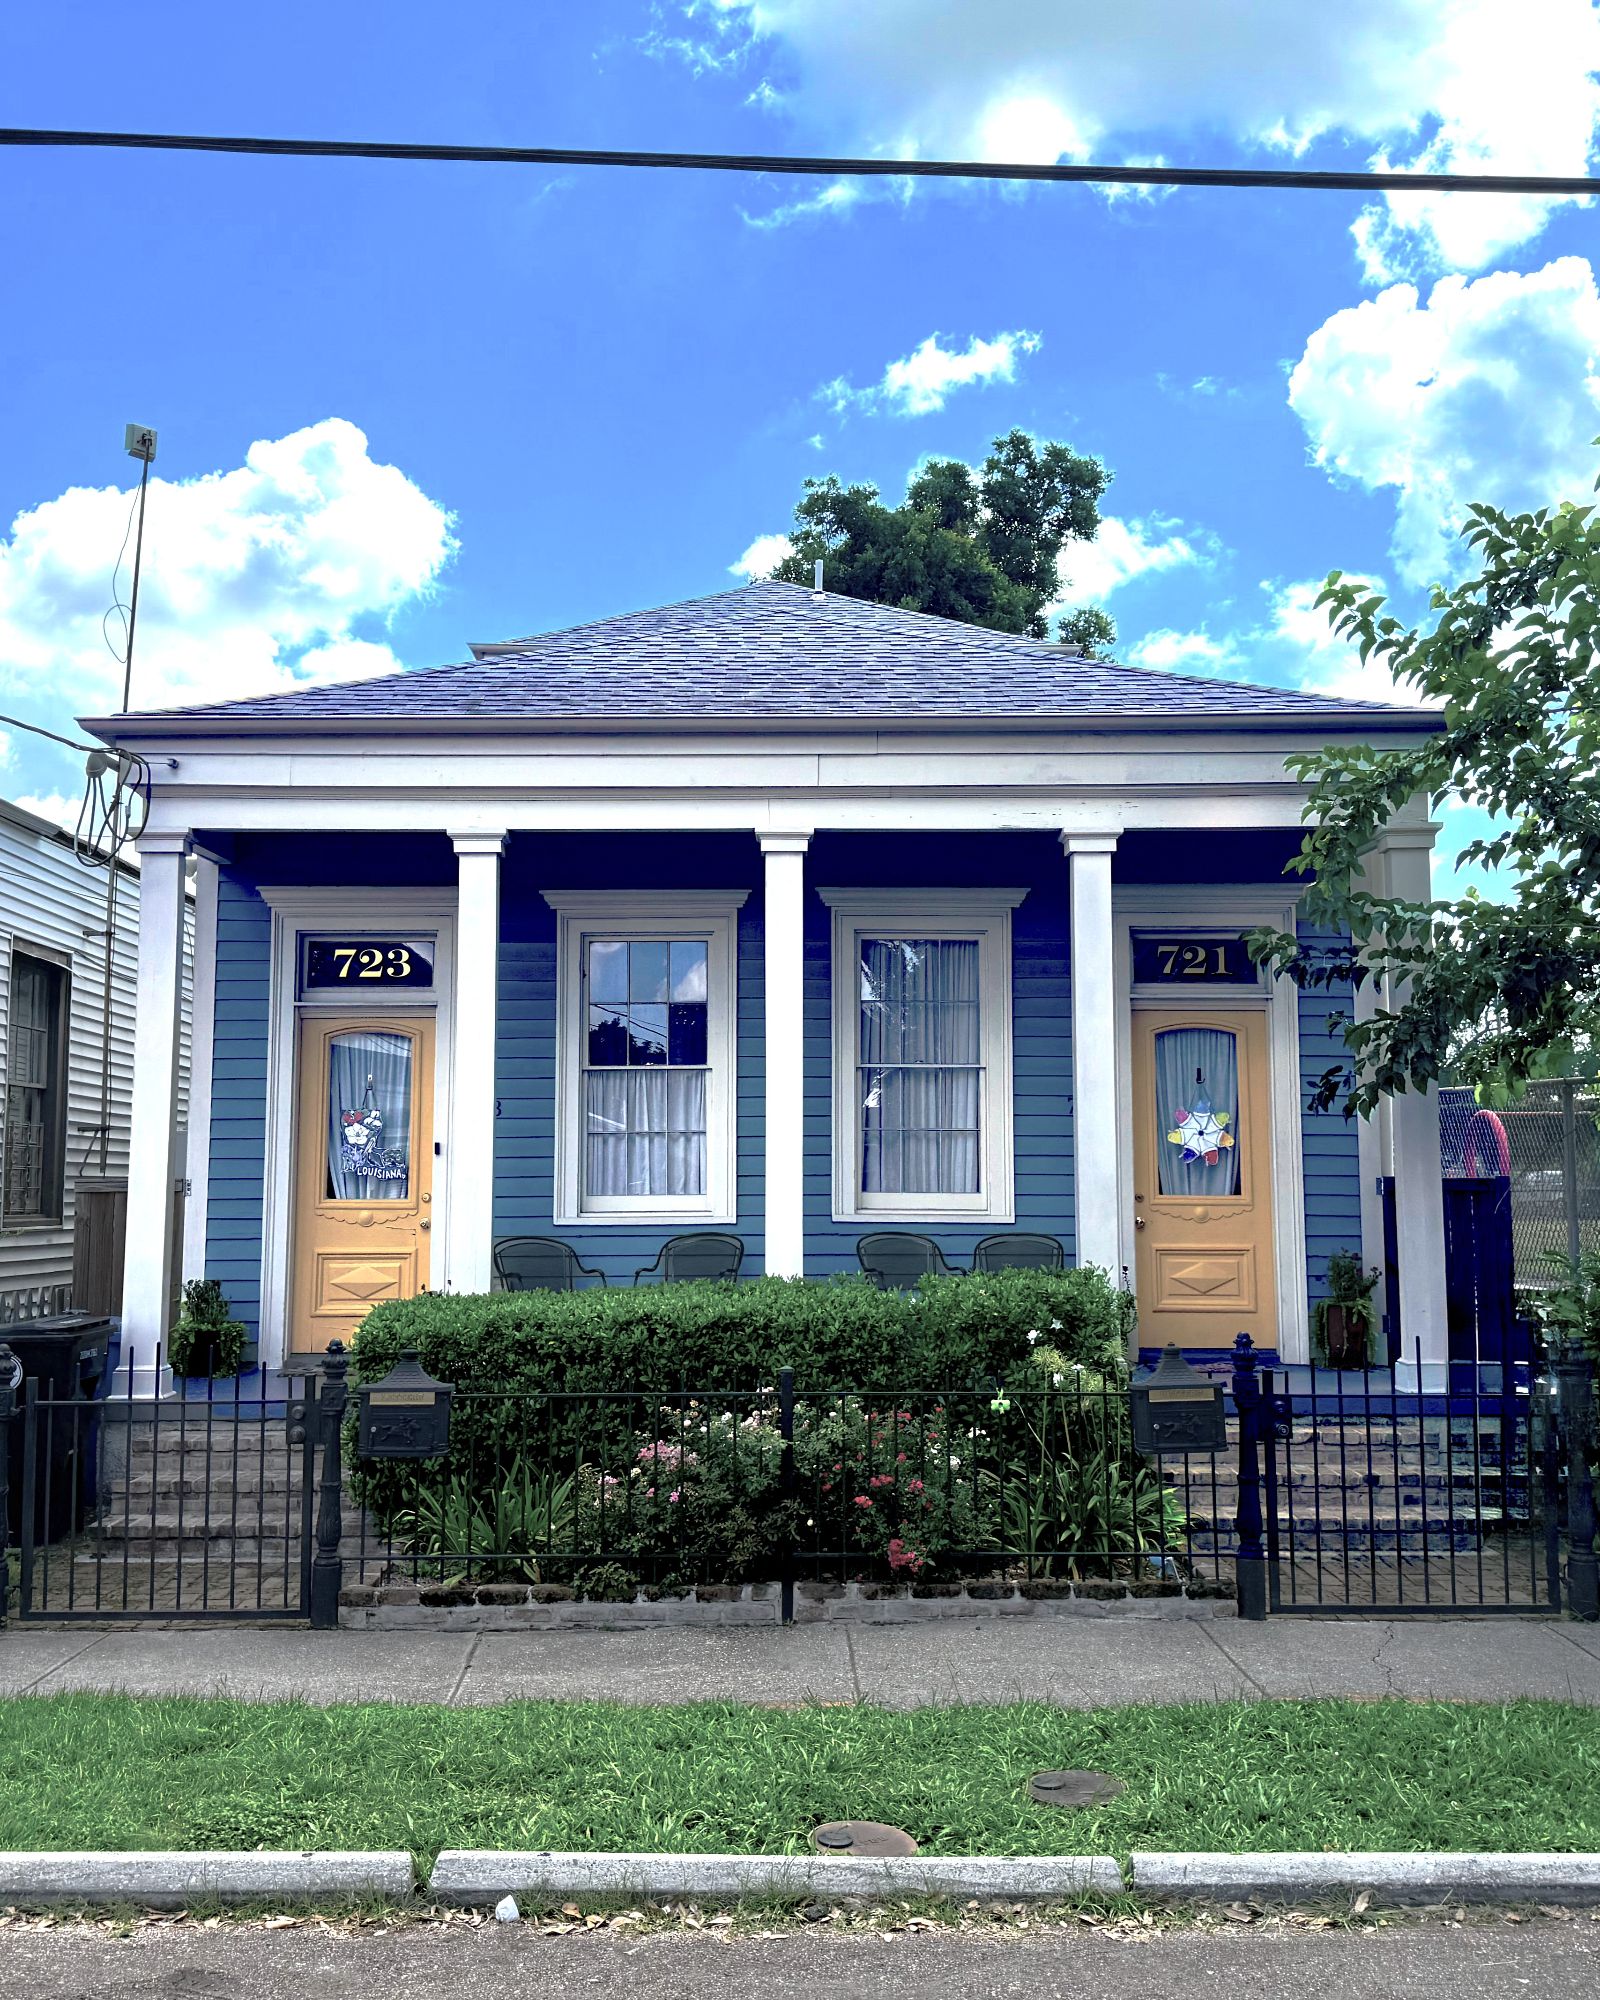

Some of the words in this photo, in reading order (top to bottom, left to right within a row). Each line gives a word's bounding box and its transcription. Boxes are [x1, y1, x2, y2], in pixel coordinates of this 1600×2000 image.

[333, 948, 412, 978] 723
[1157, 945, 1233, 975] 721
[357, 1166, 402, 1180] LOUISIANA
